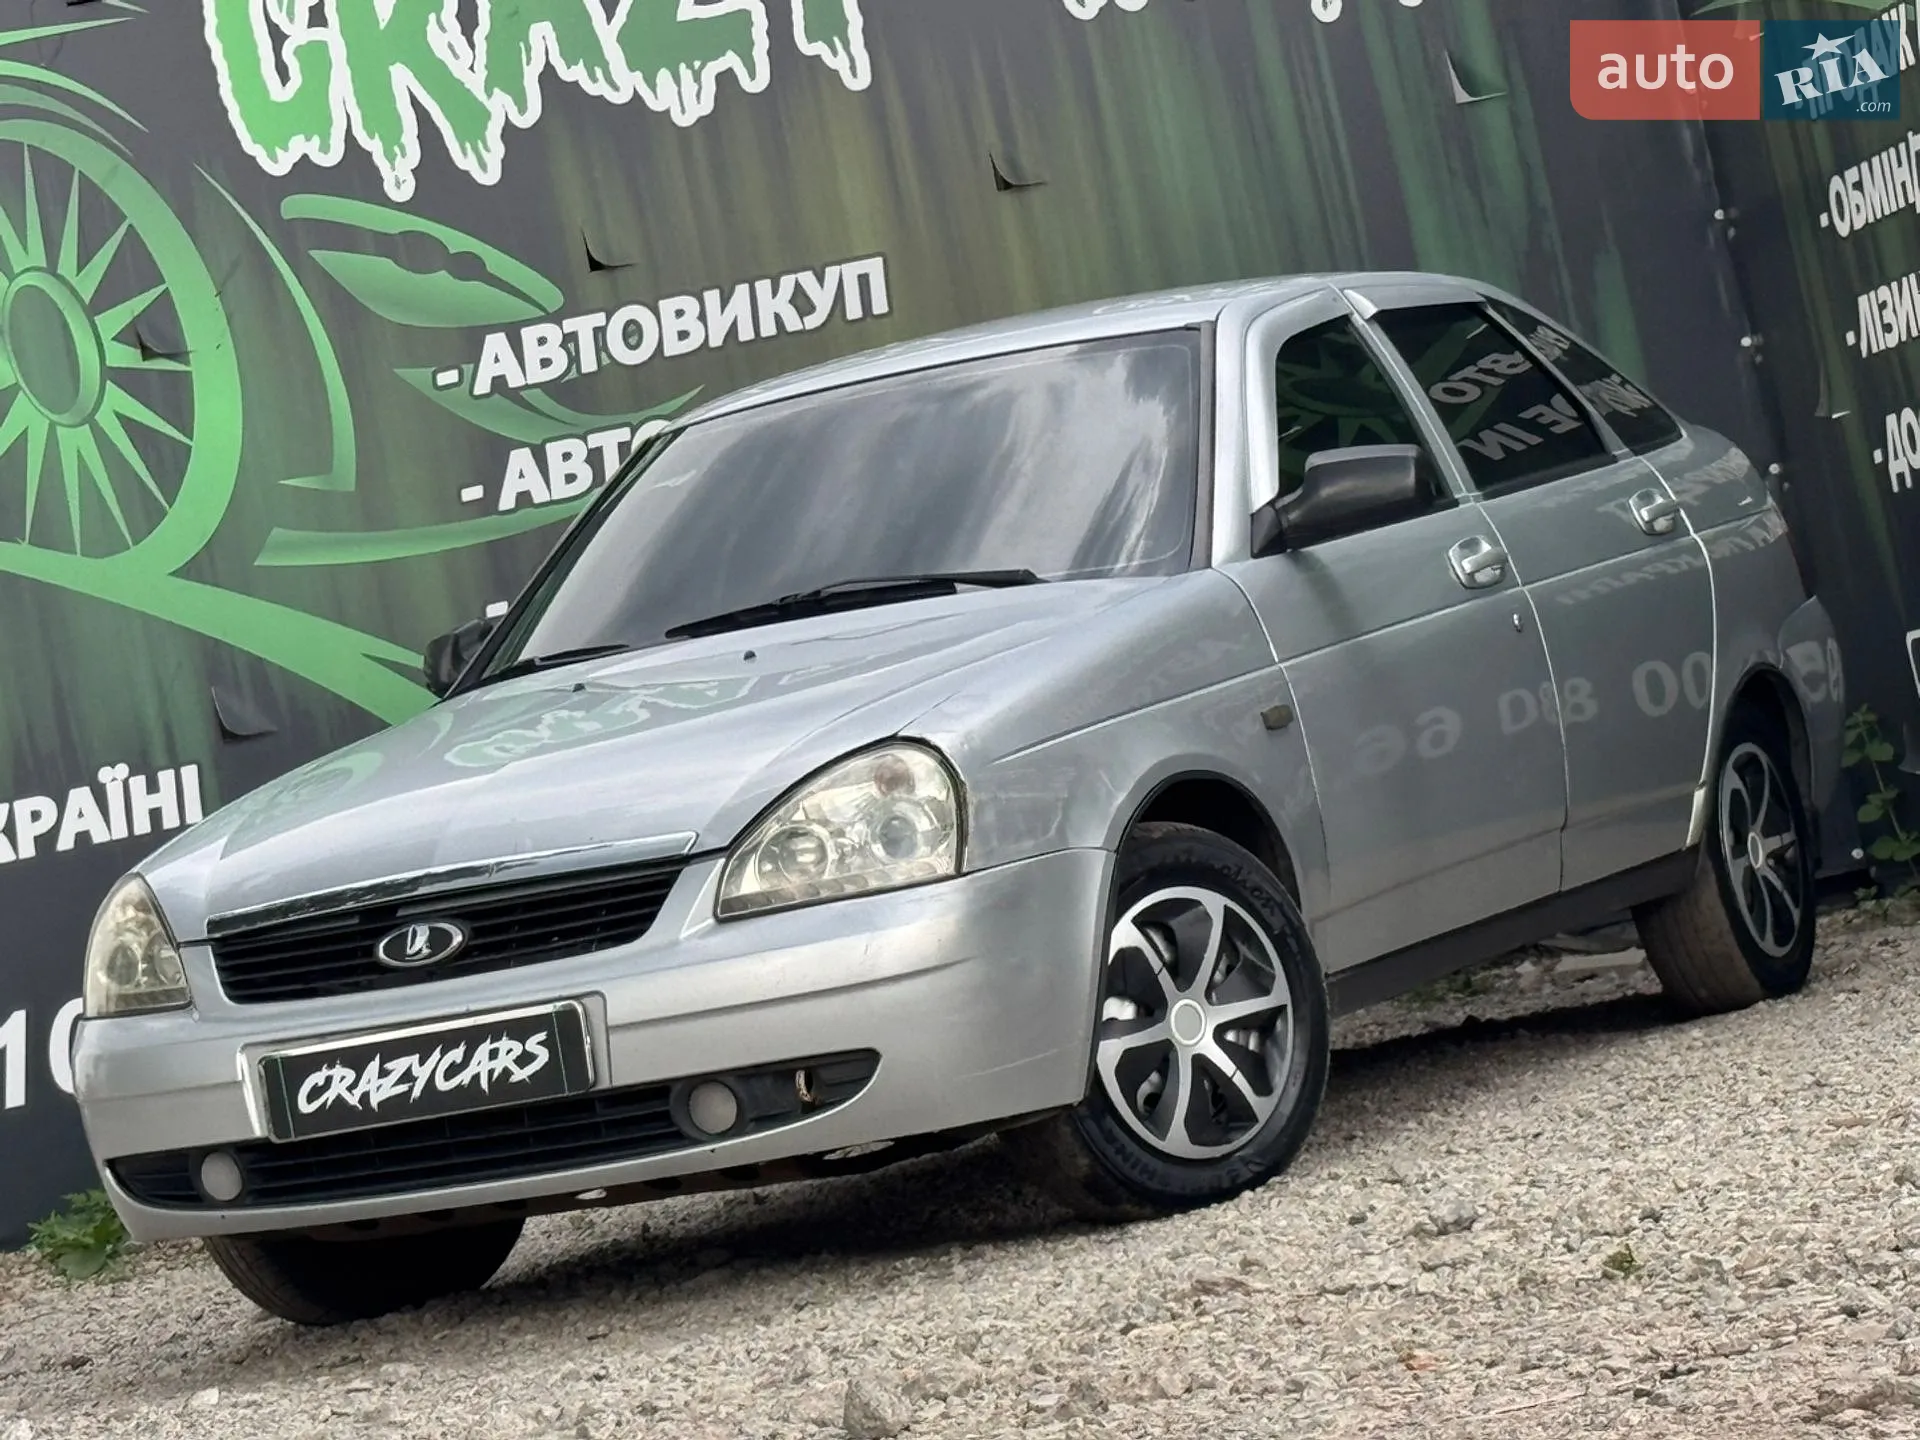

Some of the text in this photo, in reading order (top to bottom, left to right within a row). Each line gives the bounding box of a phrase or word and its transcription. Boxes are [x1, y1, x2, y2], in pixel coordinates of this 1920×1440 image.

[472, 256, 889, 396] АВТОВИКУП
[498, 419, 672, 511] АВТ
[296, 1029, 550, 1114] CRAZYCARS
